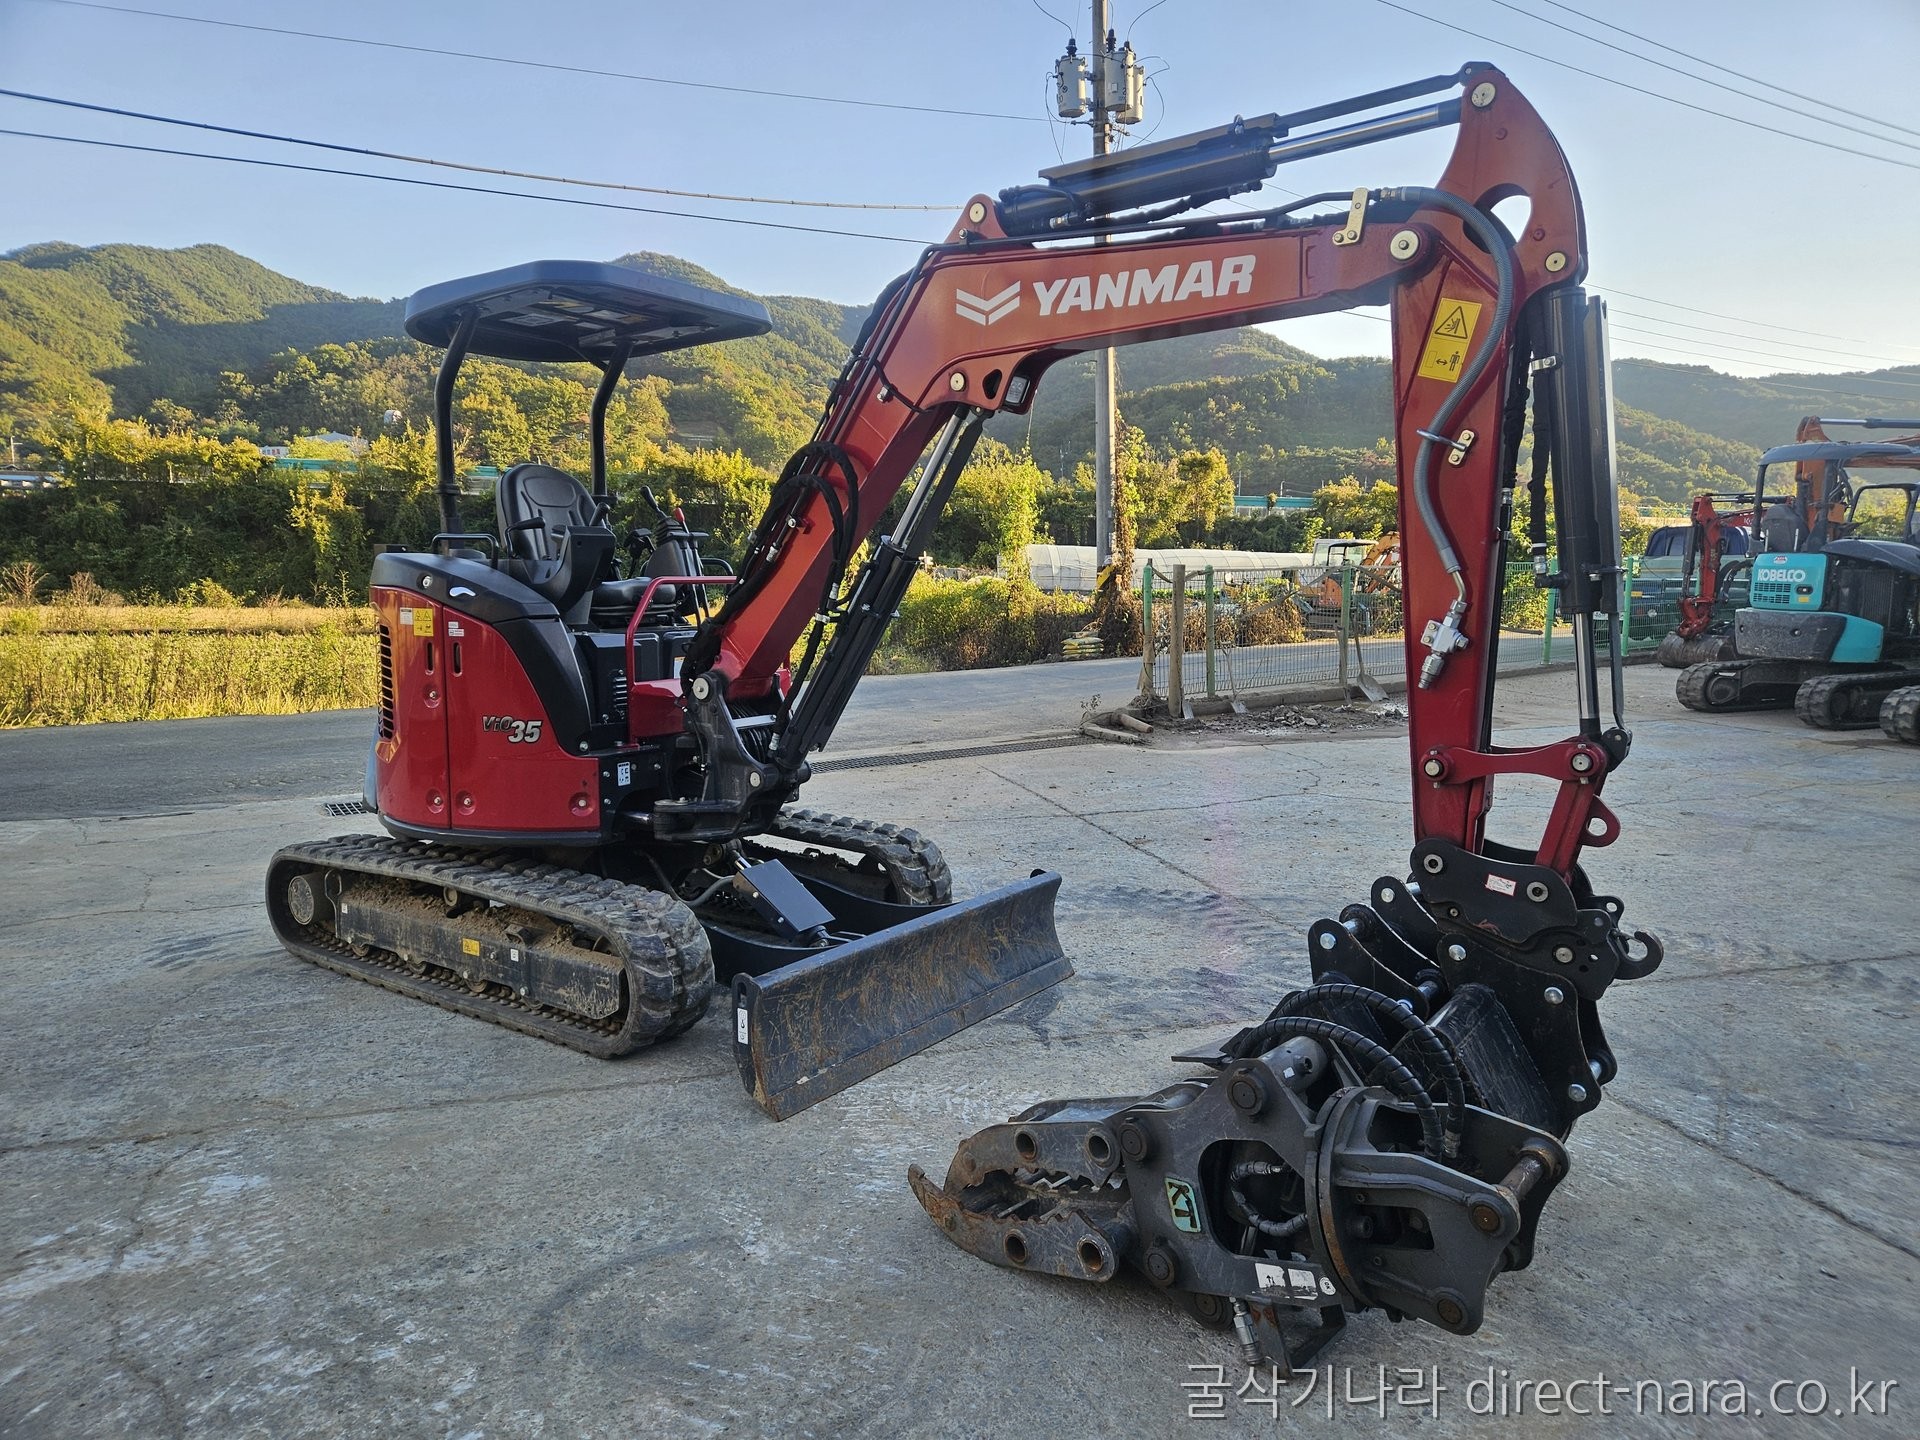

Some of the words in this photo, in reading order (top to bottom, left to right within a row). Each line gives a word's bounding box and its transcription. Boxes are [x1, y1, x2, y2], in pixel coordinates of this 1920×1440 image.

[1032, 254, 1256, 316] YANMAR
[1757, 568, 1806, 583] KOBELCO
[1167, 1181, 1198, 1229] KT
